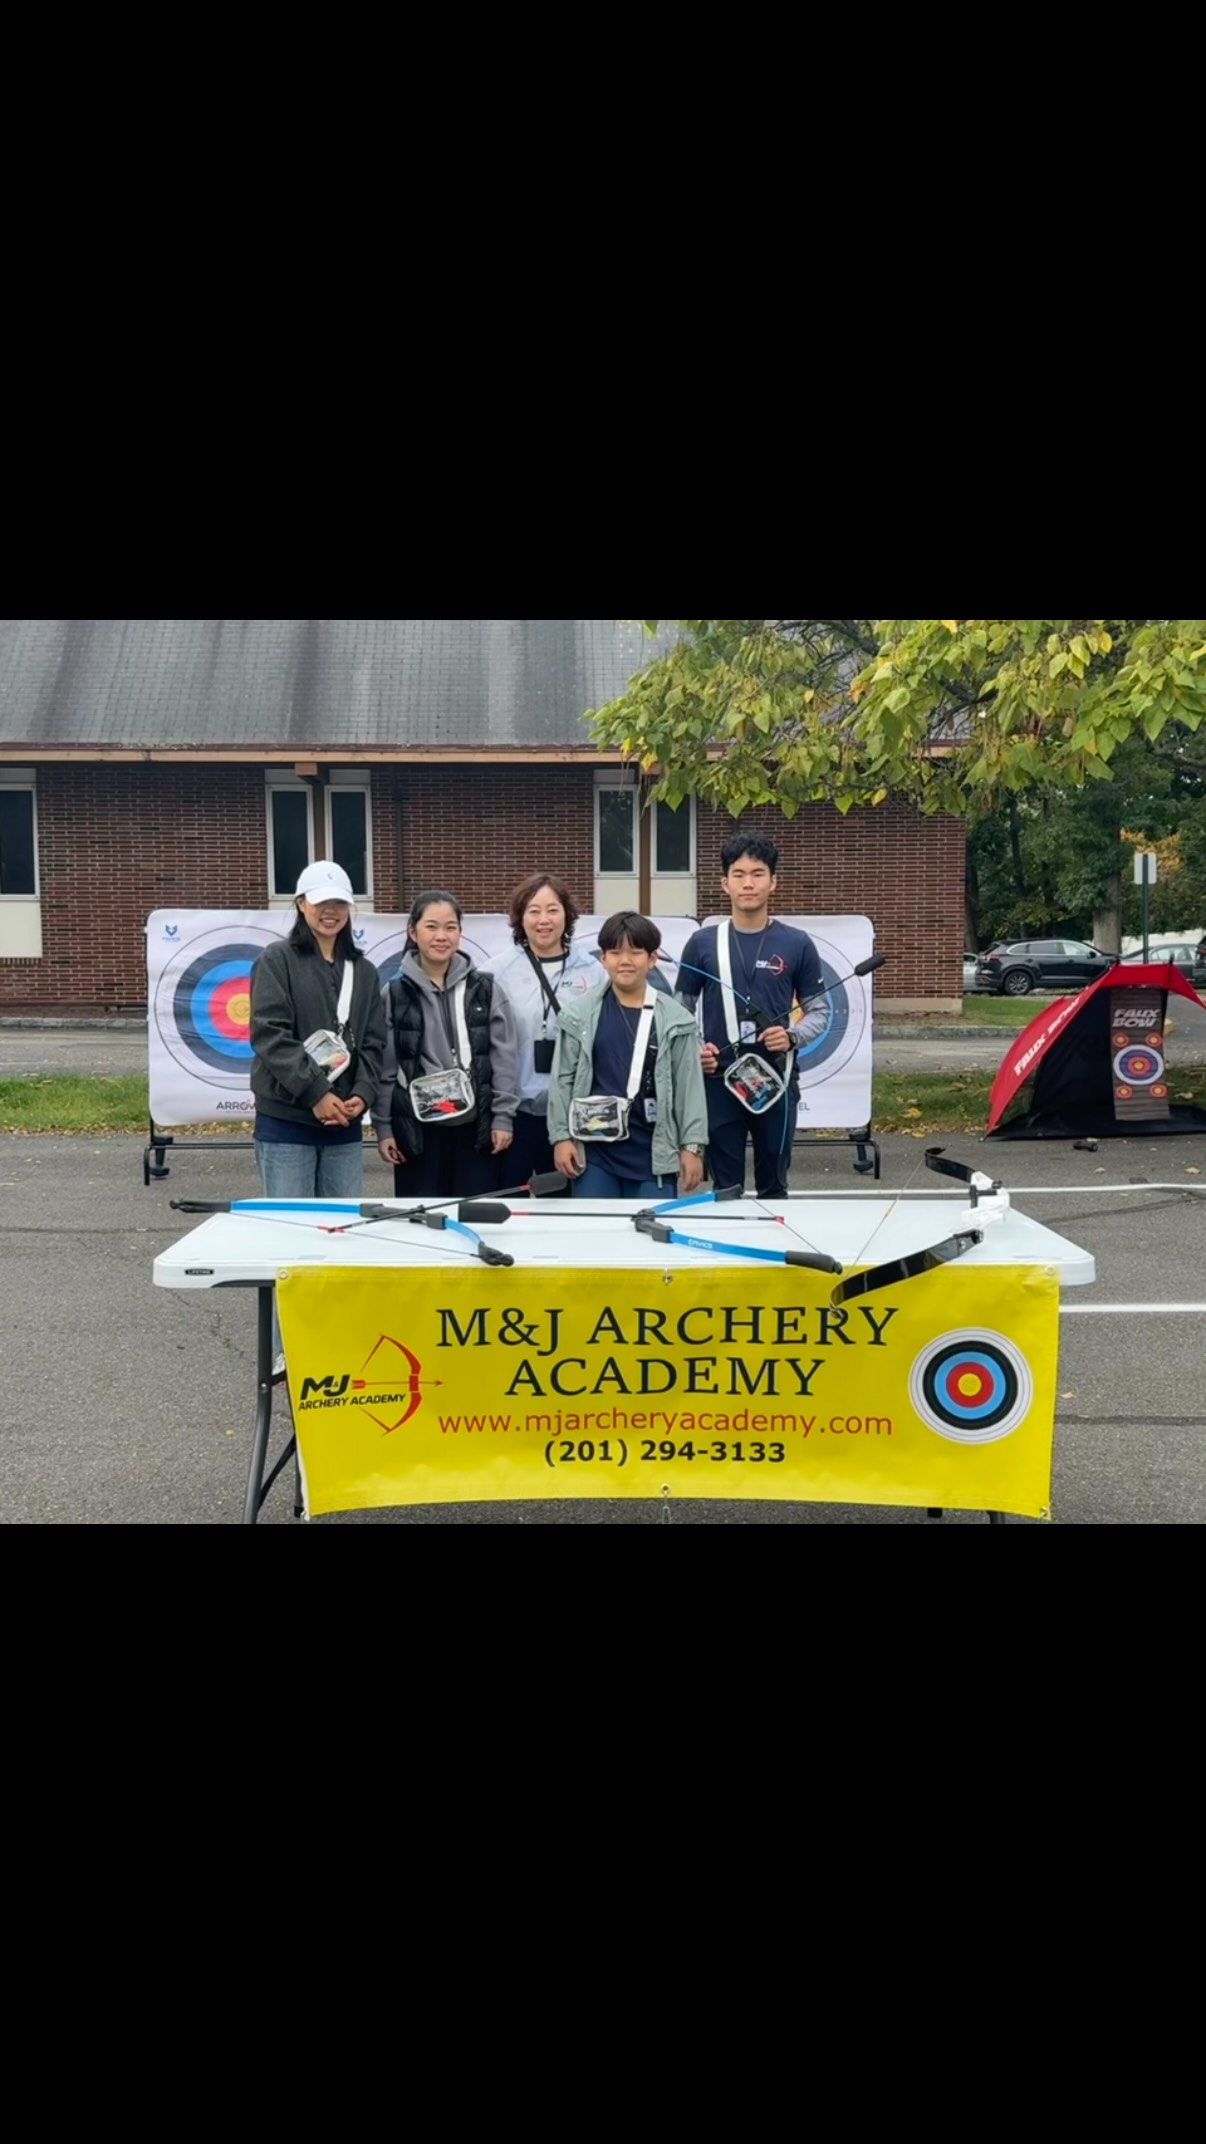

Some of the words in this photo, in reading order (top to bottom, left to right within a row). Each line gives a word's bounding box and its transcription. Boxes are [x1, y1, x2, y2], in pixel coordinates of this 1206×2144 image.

[1112, 1018, 1157, 1028] BOW
[1114, 1008, 1161, 1018] FAUX
[1014, 1033, 1047, 1076] FAUX
[436, 1307, 564, 1356] M&J
[586, 1306, 899, 1346] ARCHERY
[505, 1356, 826, 1396] ACADEMY
[298, 1397, 349, 1411] ARCHERY
[350, 1394, 406, 1406] ACADEMY
[438, 1406, 893, 1439] www.mjarcheryacademy.com
[544, 1438, 628, 1467] (201)
[640, 1439, 786, 1463] 294-3133
